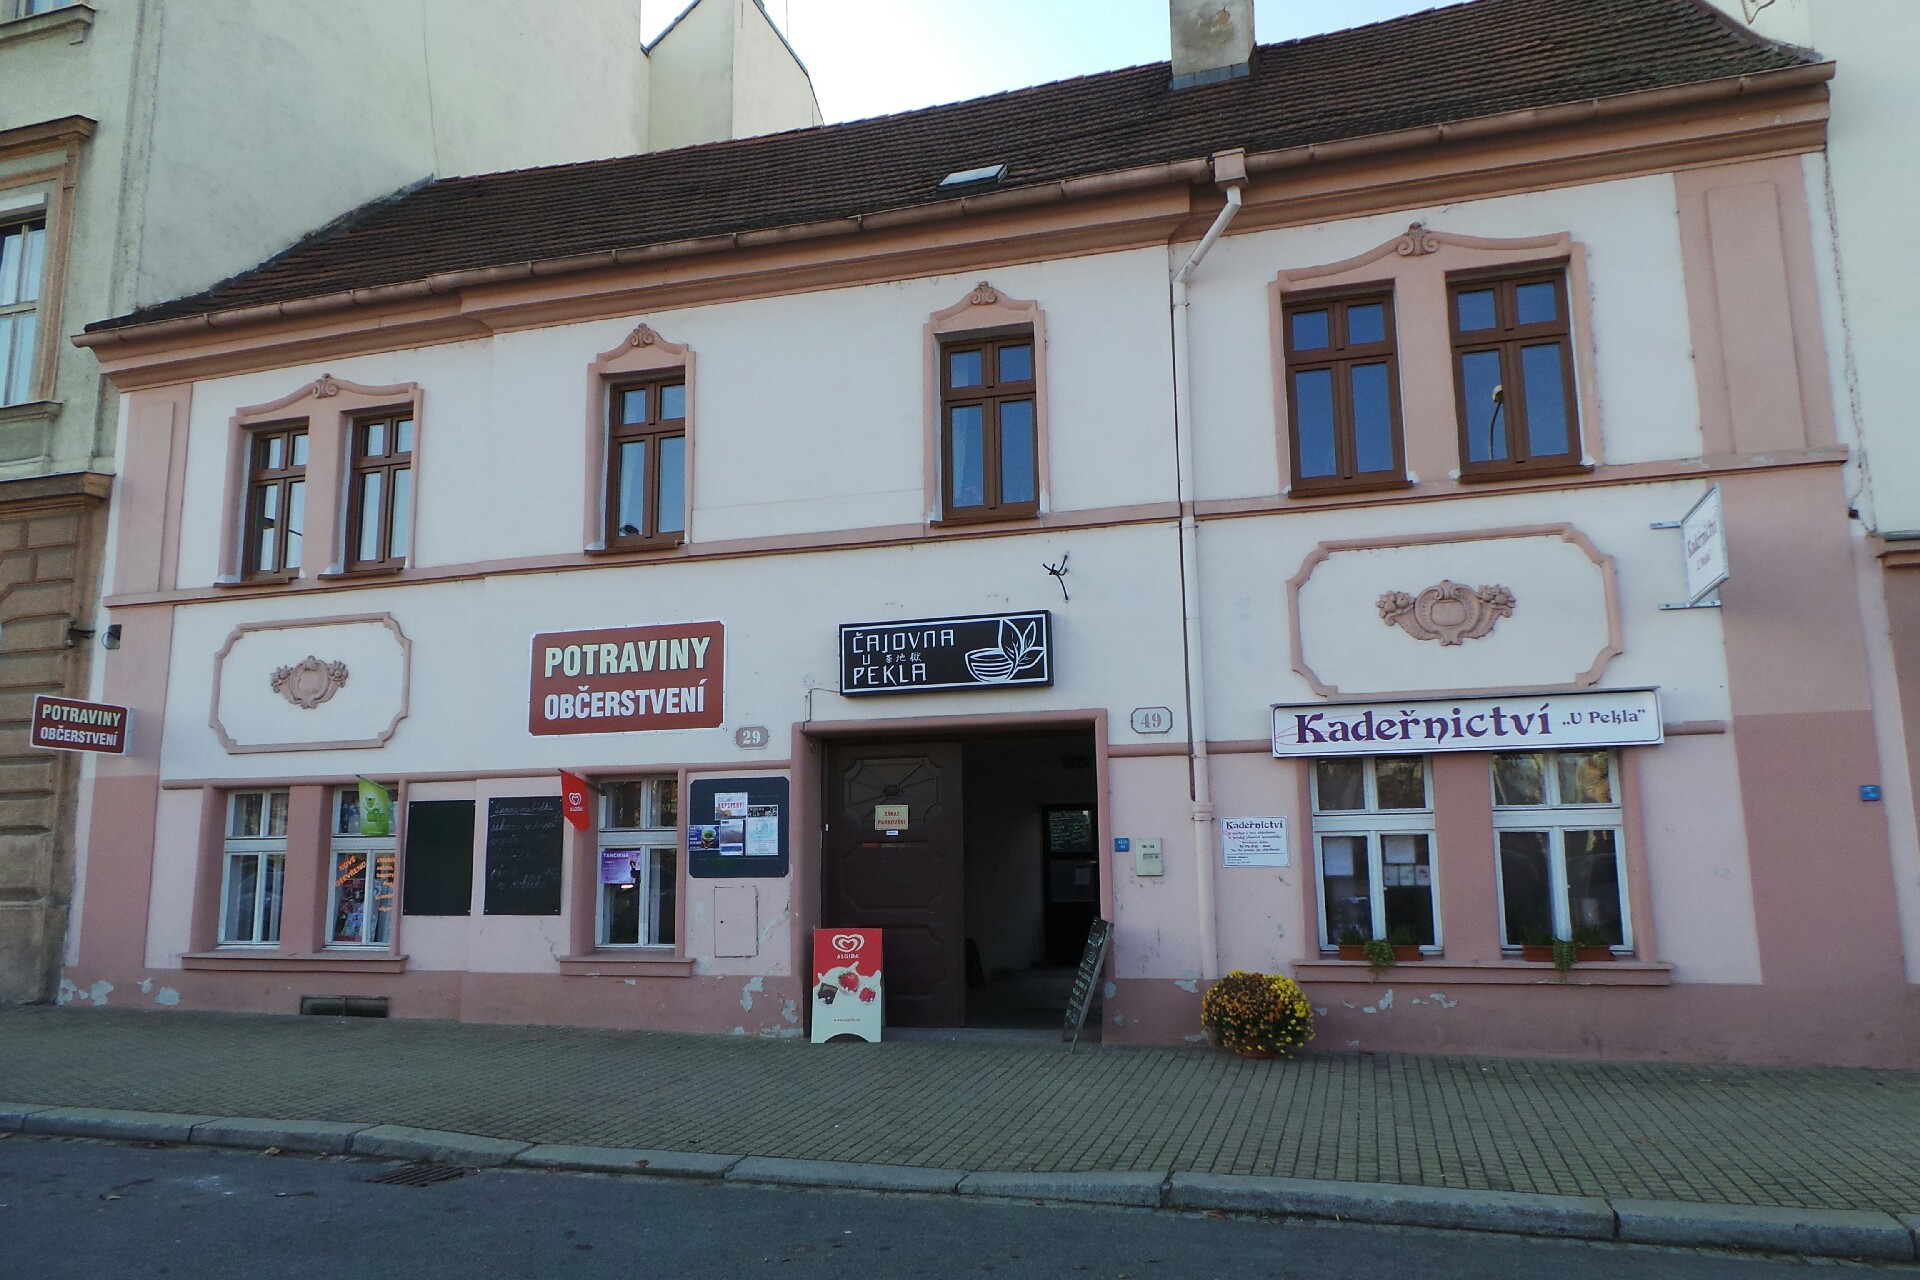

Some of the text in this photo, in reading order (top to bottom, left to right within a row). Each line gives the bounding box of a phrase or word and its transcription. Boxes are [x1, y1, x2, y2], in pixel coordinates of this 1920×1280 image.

[853, 629, 955, 653] ČAJOVNA
[544, 636, 711, 678] POTRAVINY
[862, 654, 871, 665] U
[853, 663, 927, 686] PEKLA
[544, 678, 708, 720] OBČERSTVENÍ
[41, 704, 121, 727] POTRAVINY
[1140, 713, 1162, 728] 49
[1294, 703, 1552, 745] Kadeřnictví
[40, 725, 118, 746] OBČERSTVENÍ
[742, 730, 761, 745] 29
[1226, 820, 1283, 829] Kadeřnictví
